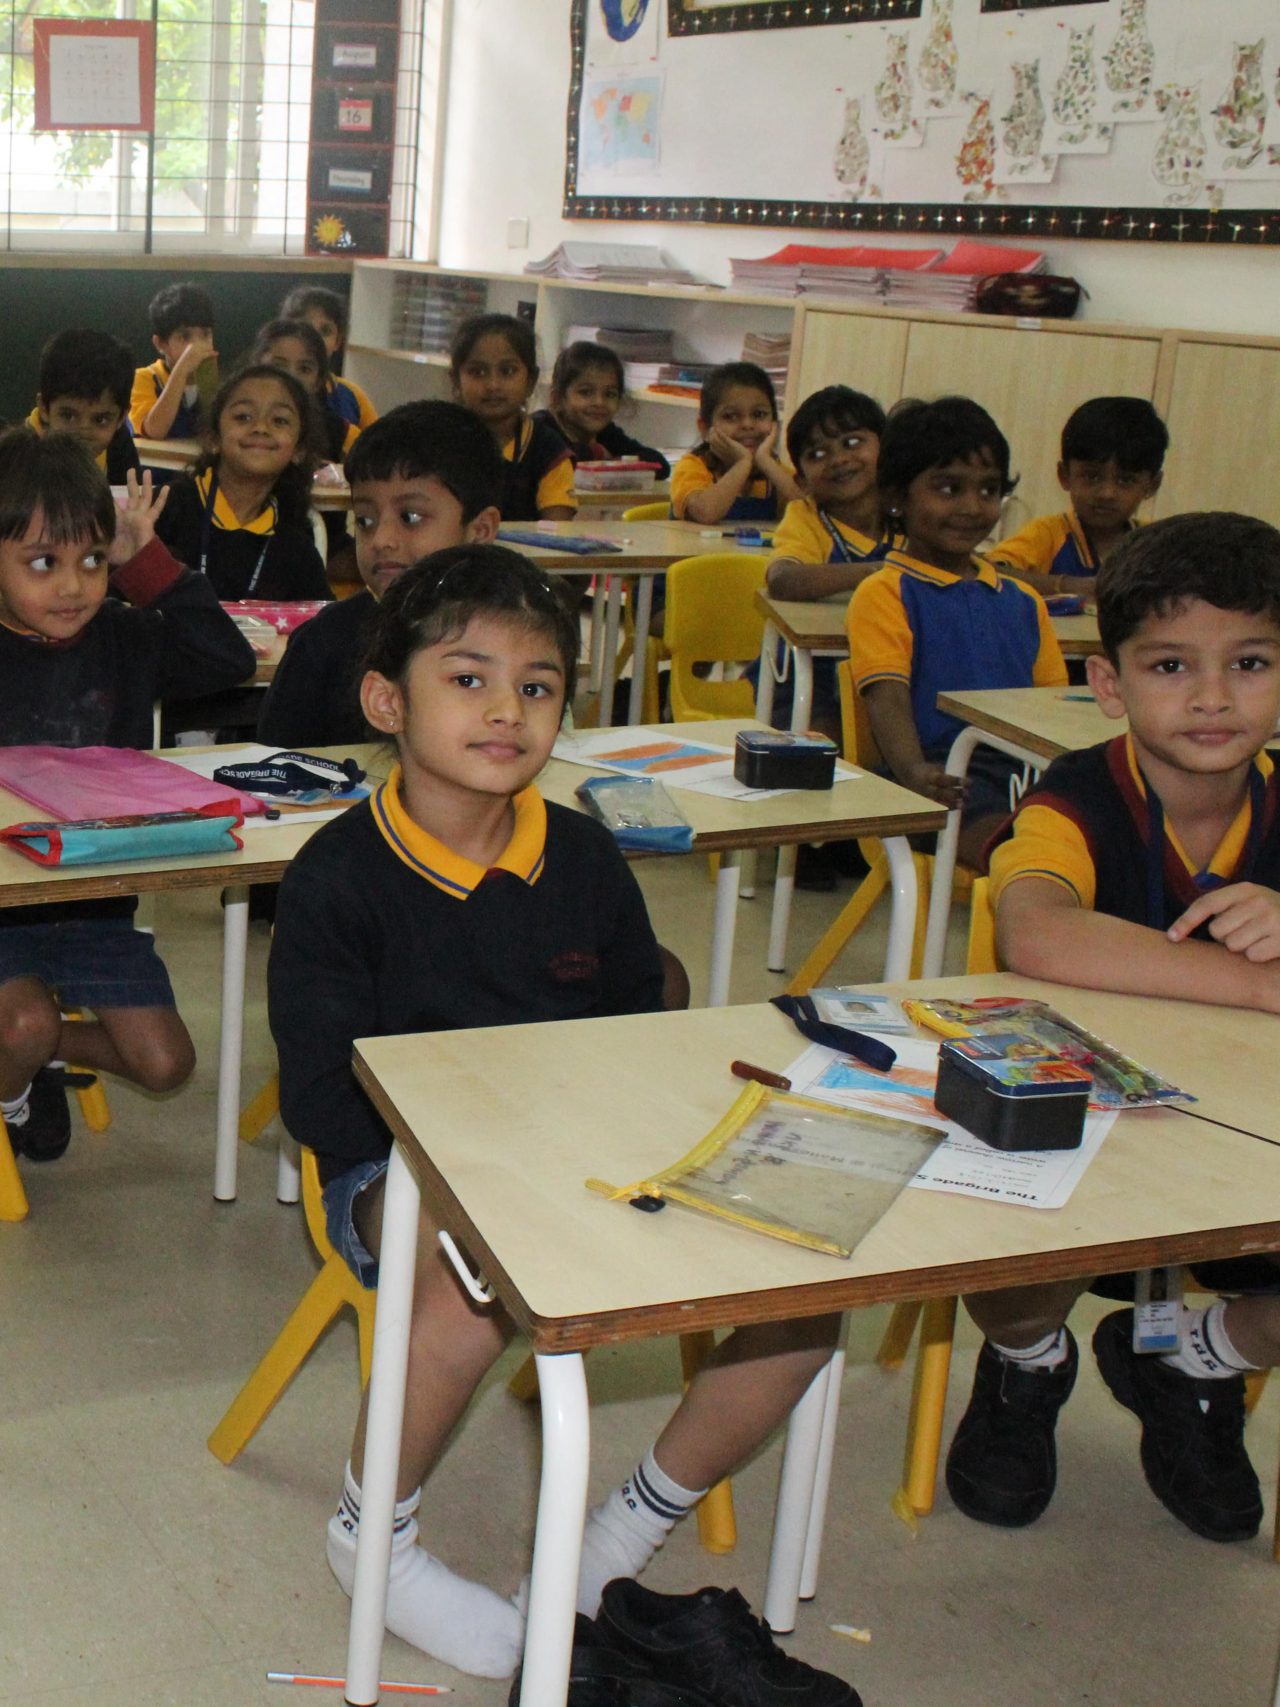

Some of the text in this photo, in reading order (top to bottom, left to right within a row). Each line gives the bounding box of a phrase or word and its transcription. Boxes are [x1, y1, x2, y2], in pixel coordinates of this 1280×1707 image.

[345, 109, 362, 124] 16
[271, 768, 287, 779] THE
[932, 1177, 1001, 1194] Brigade
[1006, 1190, 1039, 1201] The
